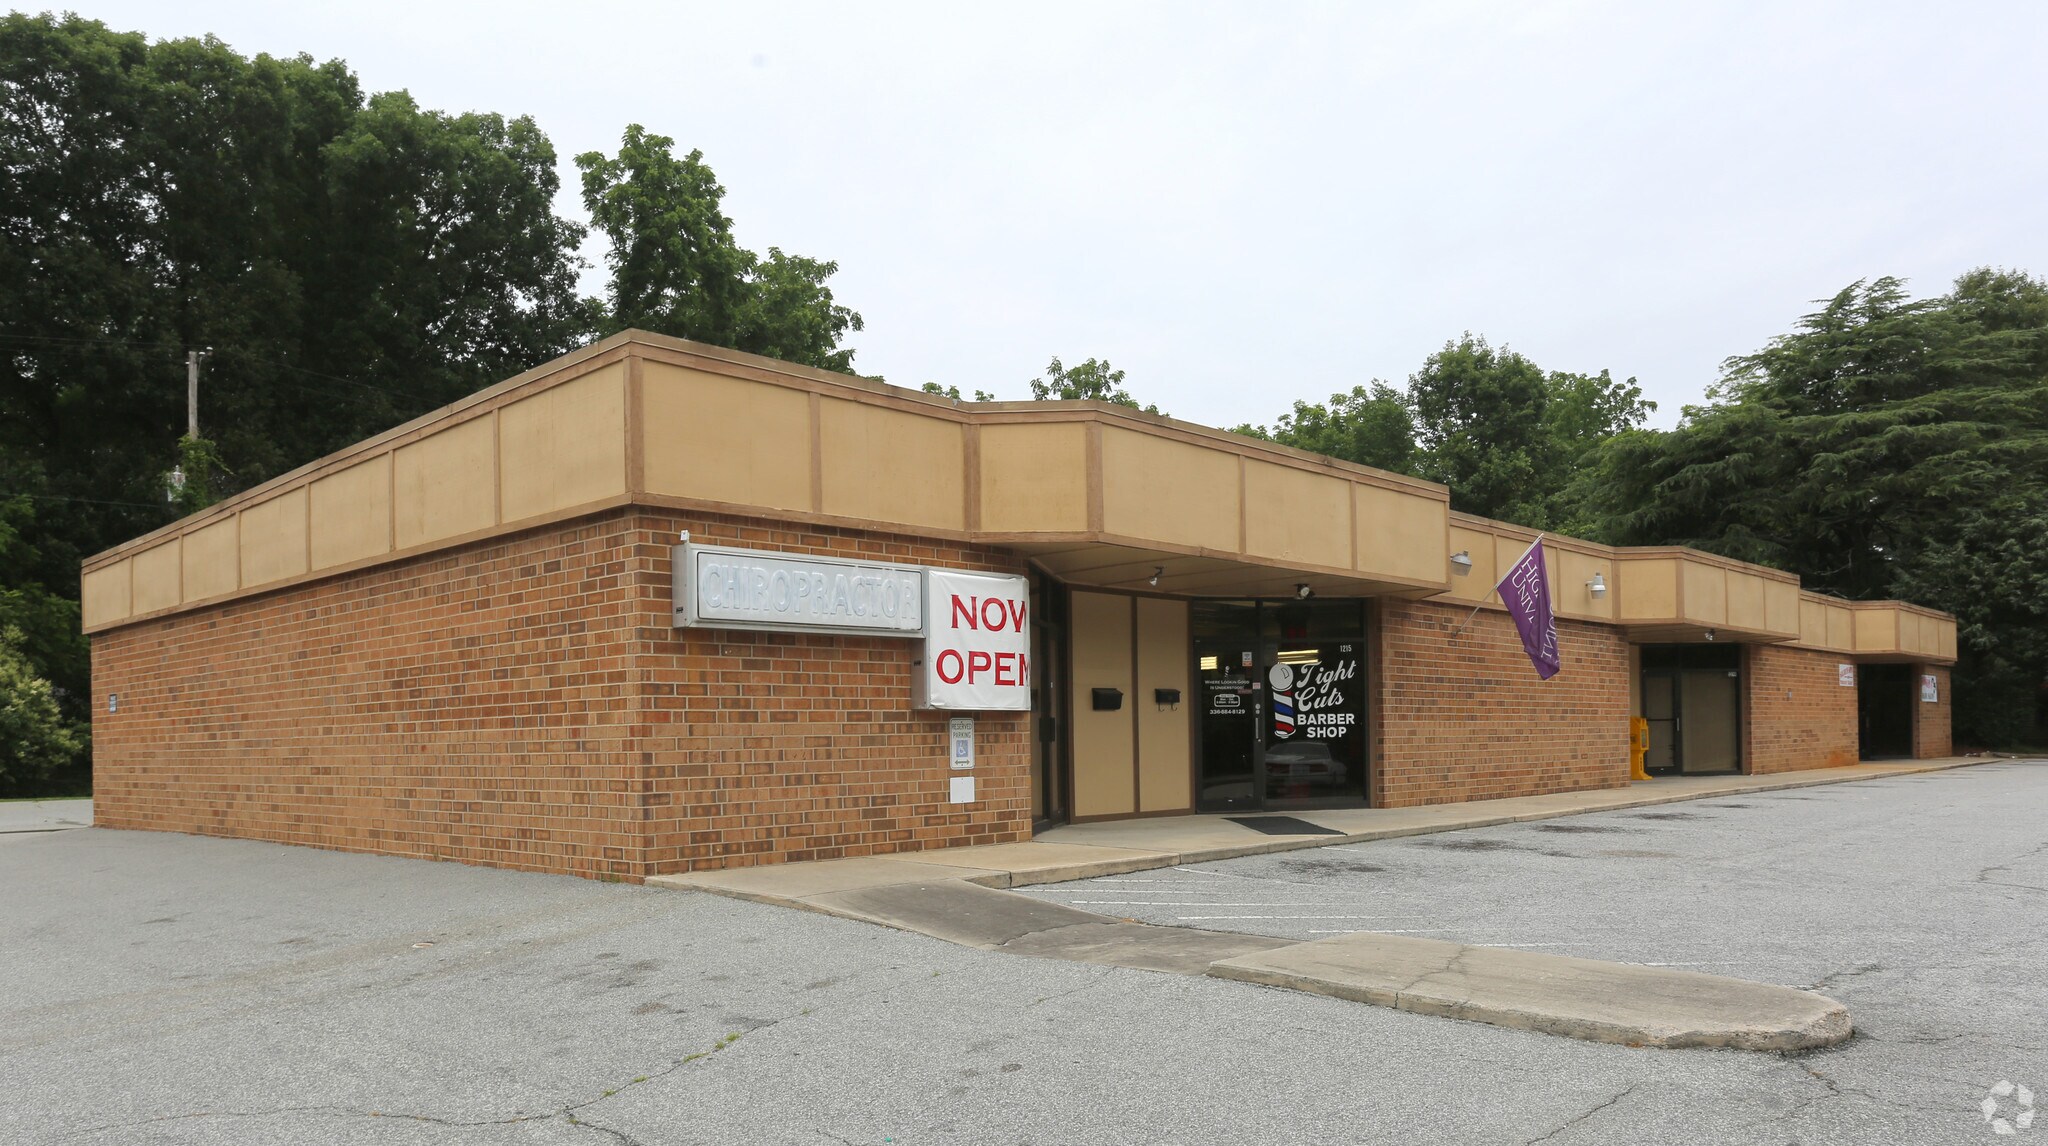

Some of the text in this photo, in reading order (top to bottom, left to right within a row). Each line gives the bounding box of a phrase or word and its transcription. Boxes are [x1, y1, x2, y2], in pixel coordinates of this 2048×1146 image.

[1521, 555, 1541, 598] HIG
[703, 563, 917, 620] CHIROPRACTOR
[1340, 645, 1352, 653] 1215
[1296, 659, 1357, 693] Tight
[1294, 686, 1345, 712] Cuts
[1297, 713, 1355, 725] BARBER
[952, 731, 971, 739] PARKING
[1307, 726, 1347, 738] SHOP
